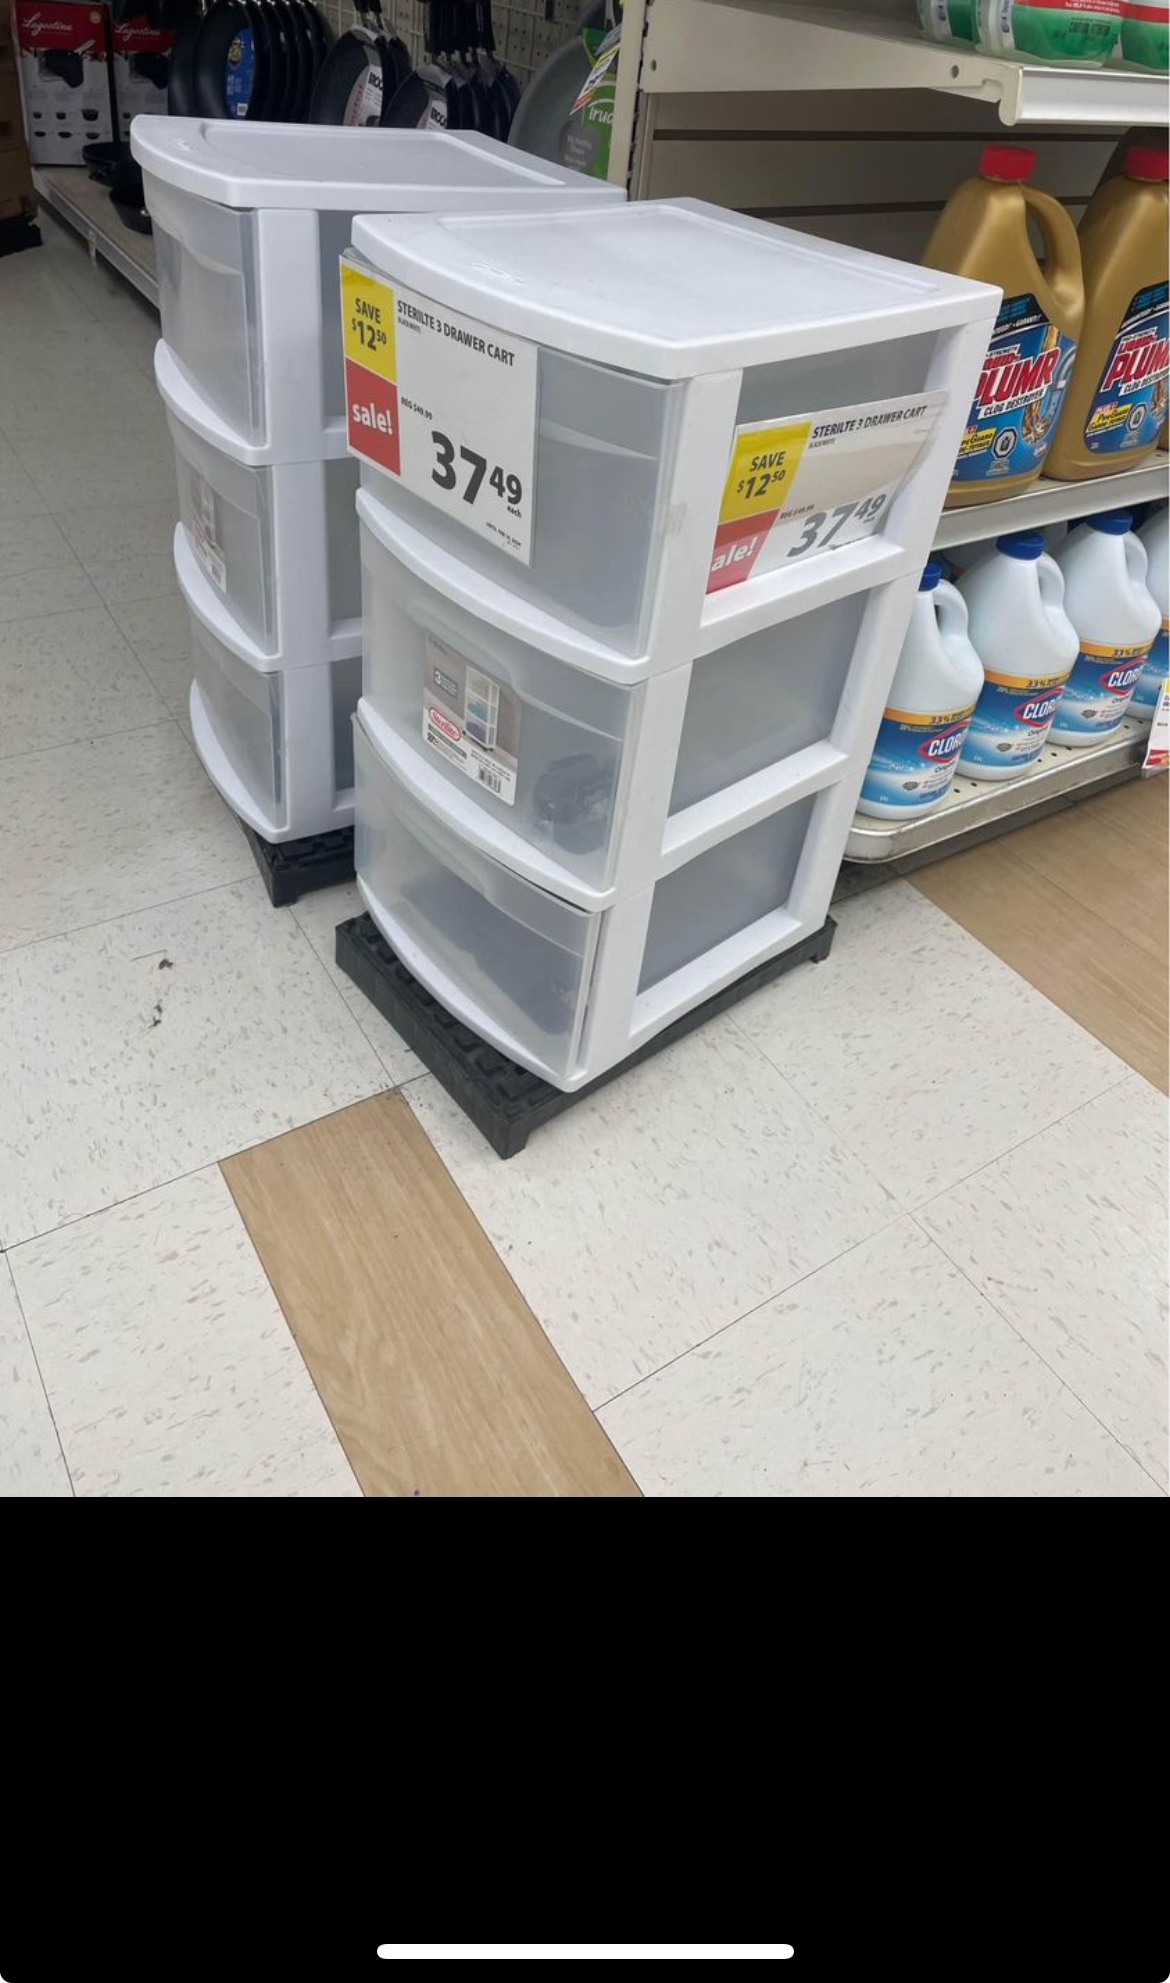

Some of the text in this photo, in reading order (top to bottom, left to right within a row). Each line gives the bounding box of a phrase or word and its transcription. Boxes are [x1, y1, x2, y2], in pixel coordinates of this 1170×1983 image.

[355, 298, 381, 325] SAVE
[436, 320, 442, 333] 3
[443, 323, 486, 354] DRAWER
[487, 343, 515, 367] CART
[1103, 341, 1169, 389] PLUM
[352, 402, 393, 435] sale!
[855, 415, 864, 430] 3
[864, 409, 903, 429] DRAWER
[903, 405, 927, 420] CART
[749, 450, 786, 472] SAVE
[507, 505, 522, 518] each
[712, 536, 759, 572] ale!
